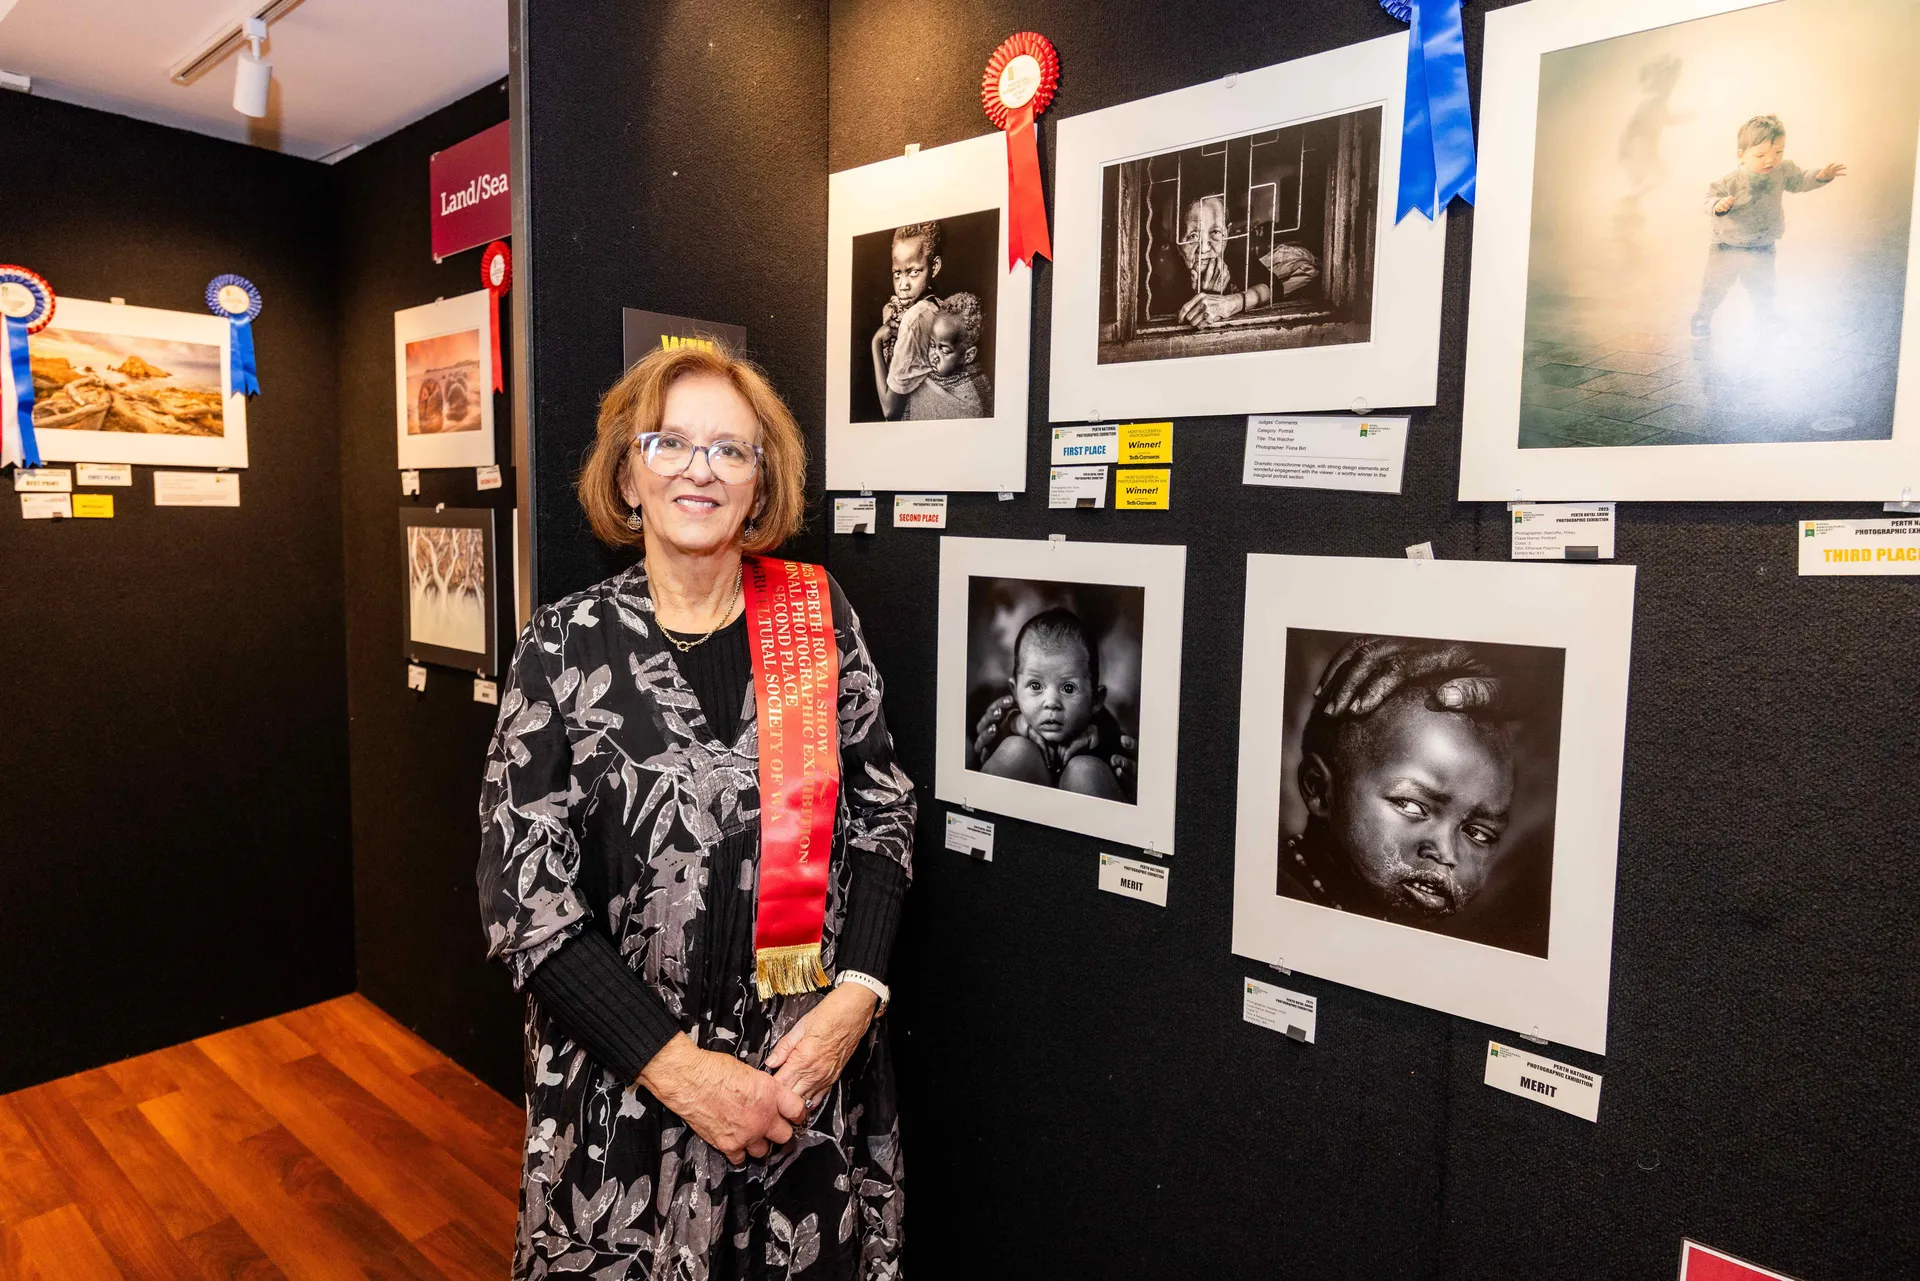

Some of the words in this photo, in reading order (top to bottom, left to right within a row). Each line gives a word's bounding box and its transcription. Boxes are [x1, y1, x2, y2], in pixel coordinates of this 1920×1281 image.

[440, 173, 509, 217] Land/Sea
[1063, 446, 1083, 456] FIRST
[1084, 445, 1107, 455] PLACE
[1128, 441, 1161, 449] Winner!
[899, 514, 921, 522] SECOND
[922, 514, 939, 522] PLACE
[801, 562, 815, 578] 025
[1823, 548, 1872, 562] THIRD
[784, 561, 802, 598] IONAL
[752, 565, 777, 670] GRICULTURAL
[772, 585, 792, 646] SECOND
[805, 580, 823, 633] PERTH
[780, 650, 799, 707] PLACE
[790, 601, 815, 739] PHOTOGRAPHIC
[812, 637, 828, 694] ROYAL
[765, 673, 784, 754] SOCIETY
[815, 699, 829, 756] SHOW
[770, 758, 784, 786] OF
[1120, 878, 1143, 891] MERIT
[1520, 1076, 1557, 1098] MERIT
[1527, 1062, 1564, 1078] PHOTOGRAPHIC
[1565, 1074, 1593, 1088] EXHIBITION
[1554, 1064, 1569, 1073] PERTH
[1570, 1069, 1594, 1082] NATIONAL
